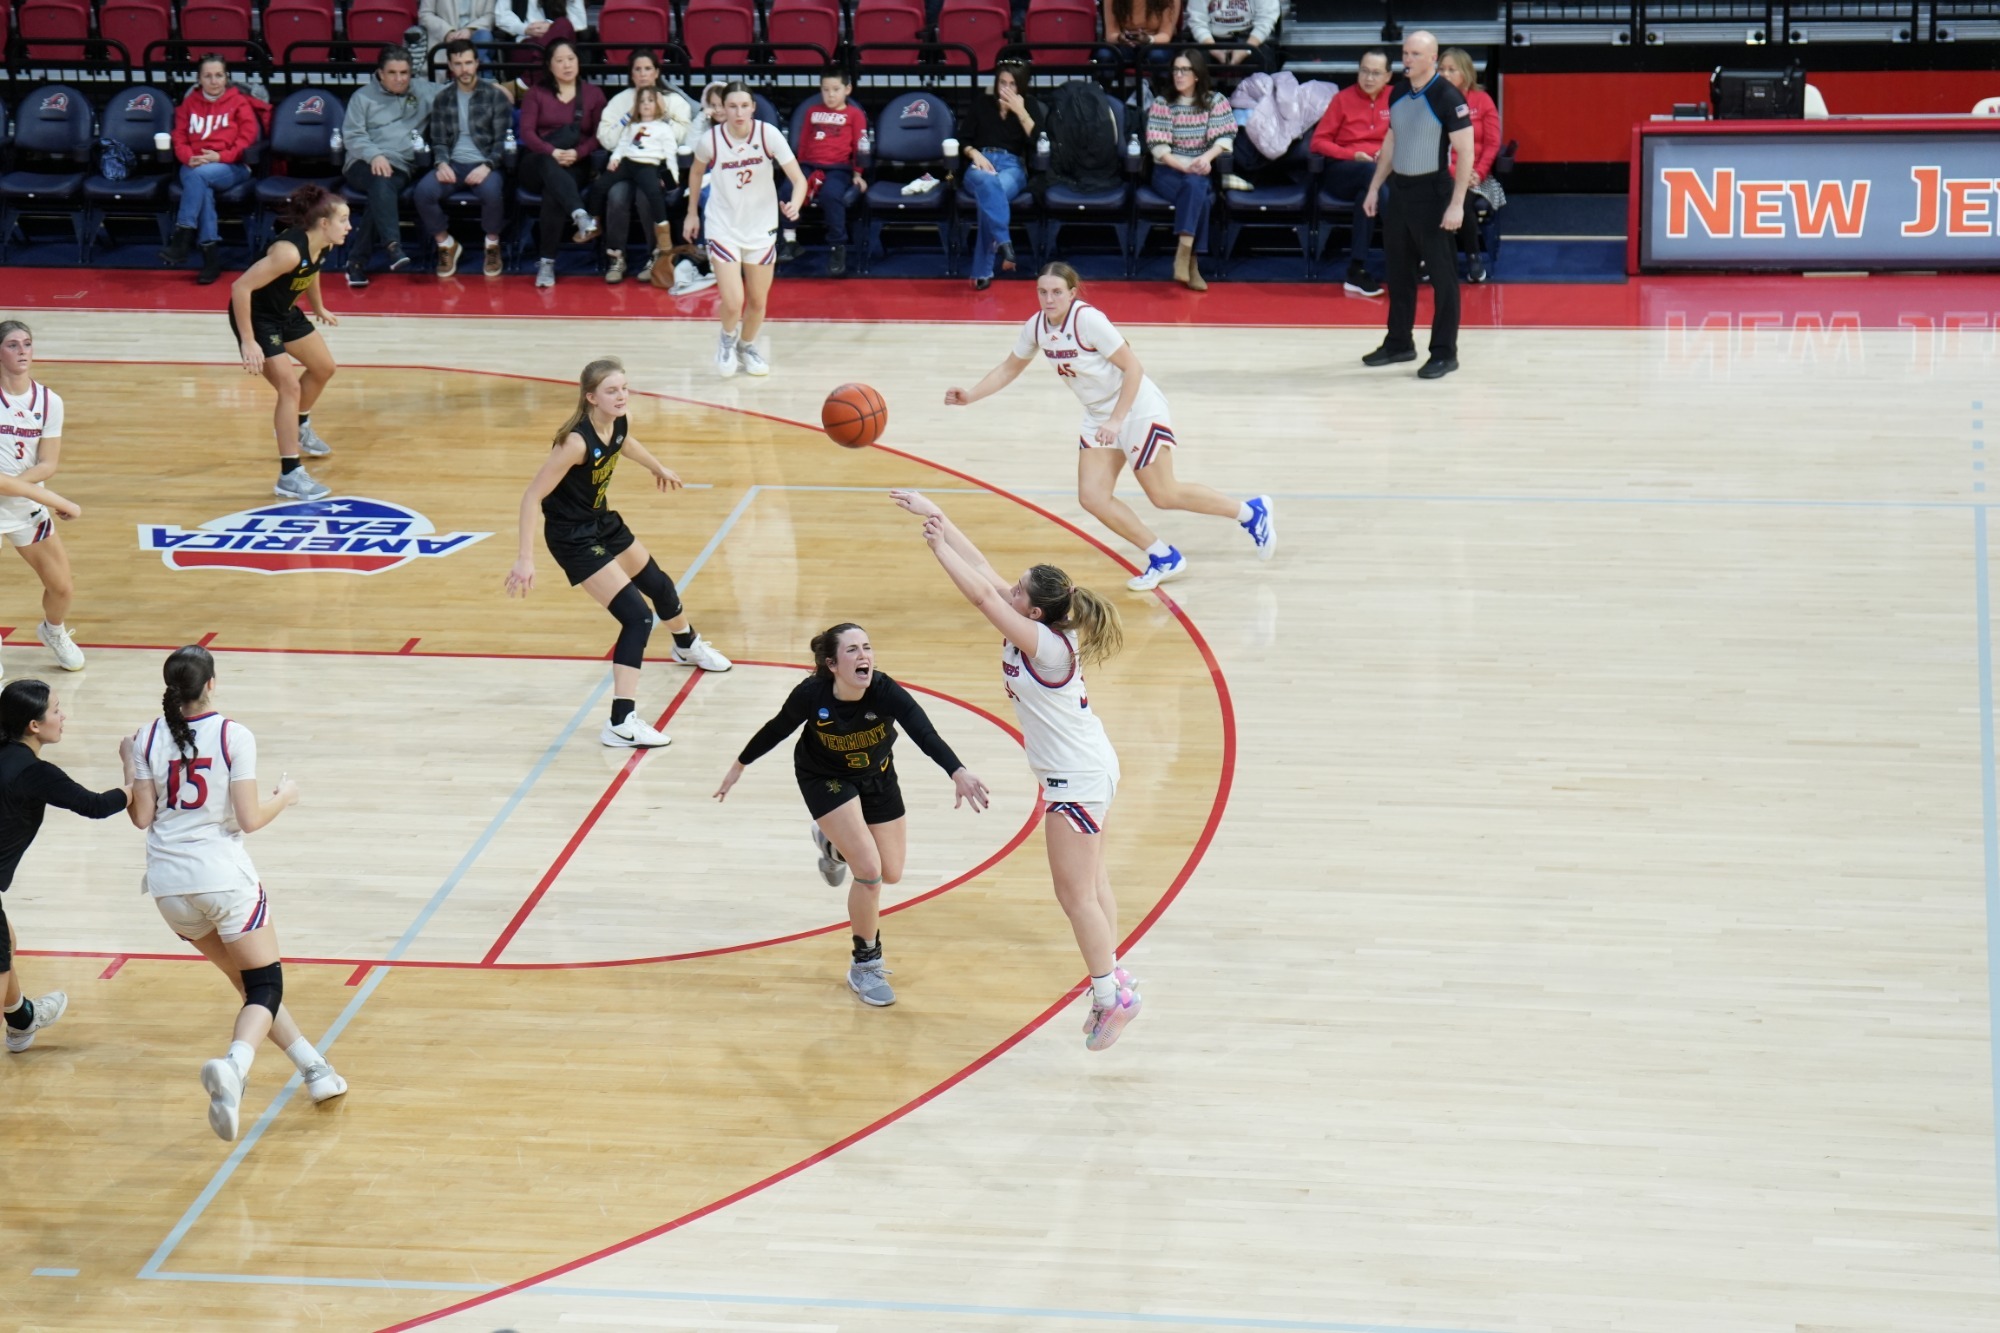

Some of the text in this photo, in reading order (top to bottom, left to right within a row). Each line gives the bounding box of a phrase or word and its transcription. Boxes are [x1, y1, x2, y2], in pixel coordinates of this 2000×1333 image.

[736, 169, 753, 189] 32
[1901, 166, 2000, 237] JE
[1057, 363, 1077, 377] 45
[15, 441, 25, 460] 3
[225, 518, 413, 536] EAST
[152, 528, 476, 554] AMERICA
[816, 723, 887, 751] VERMONT
[845, 752, 870, 768] 3
[166, 757, 212, 811] 15
